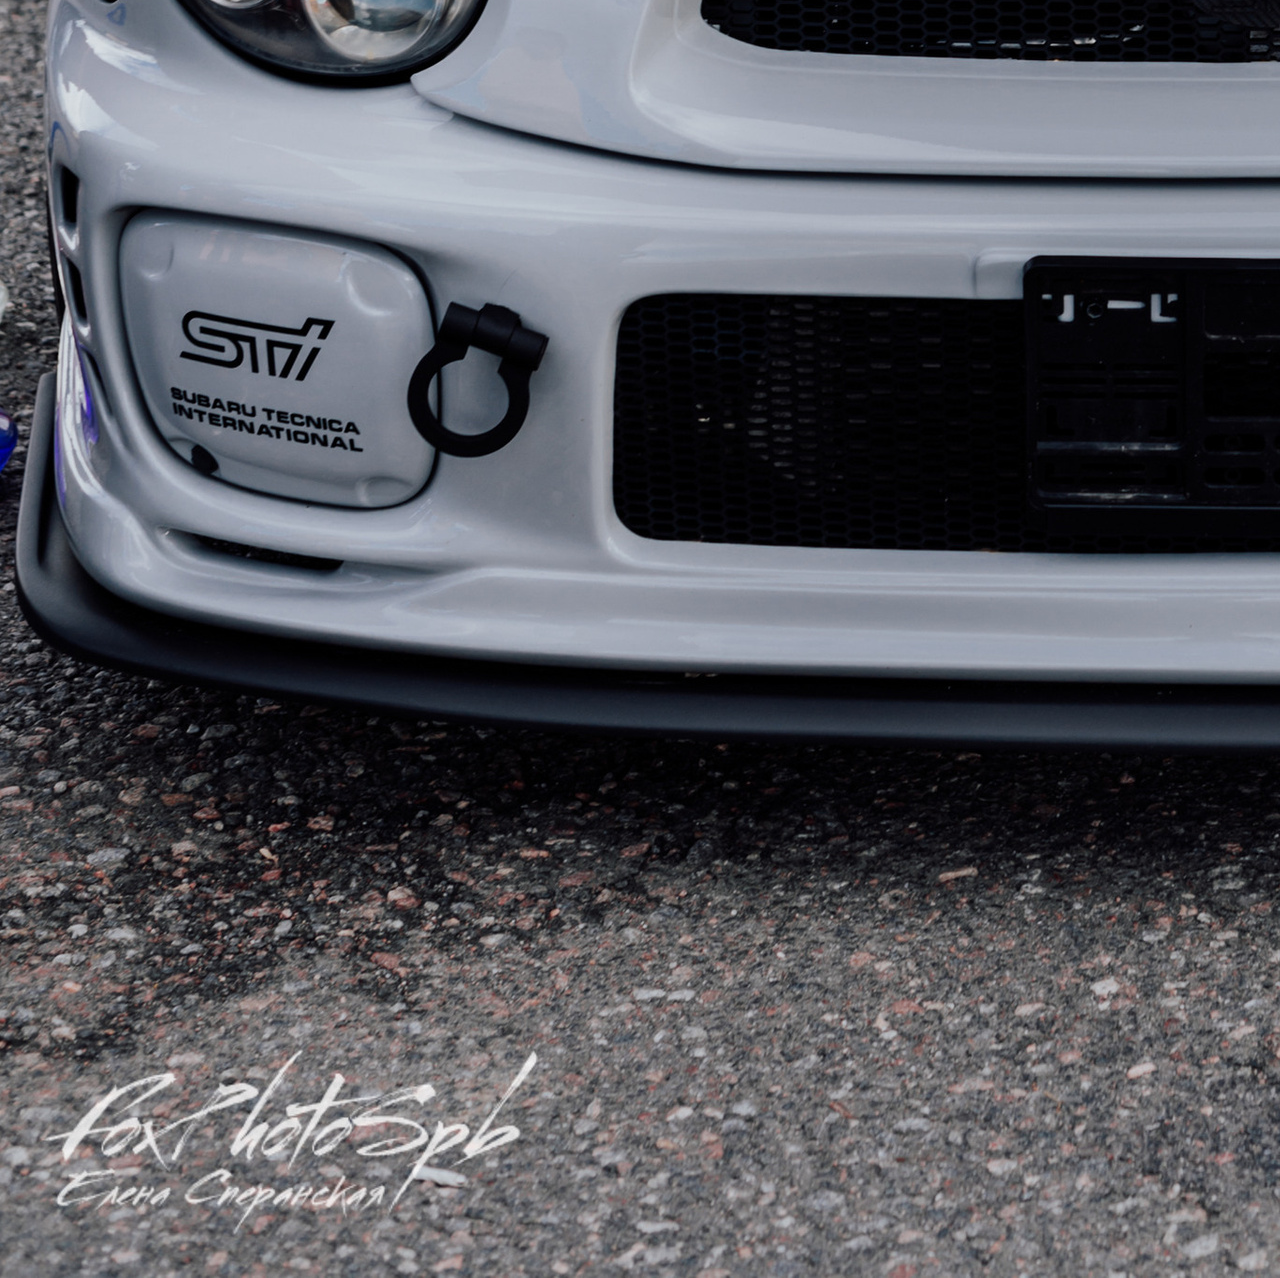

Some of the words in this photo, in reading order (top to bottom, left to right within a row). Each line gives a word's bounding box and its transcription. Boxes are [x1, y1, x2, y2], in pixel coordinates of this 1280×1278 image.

[170, 386, 258, 418] SUBARU
[262, 407, 361, 436] TECNICA
[172, 402, 365, 453] INTERNATIONAL
